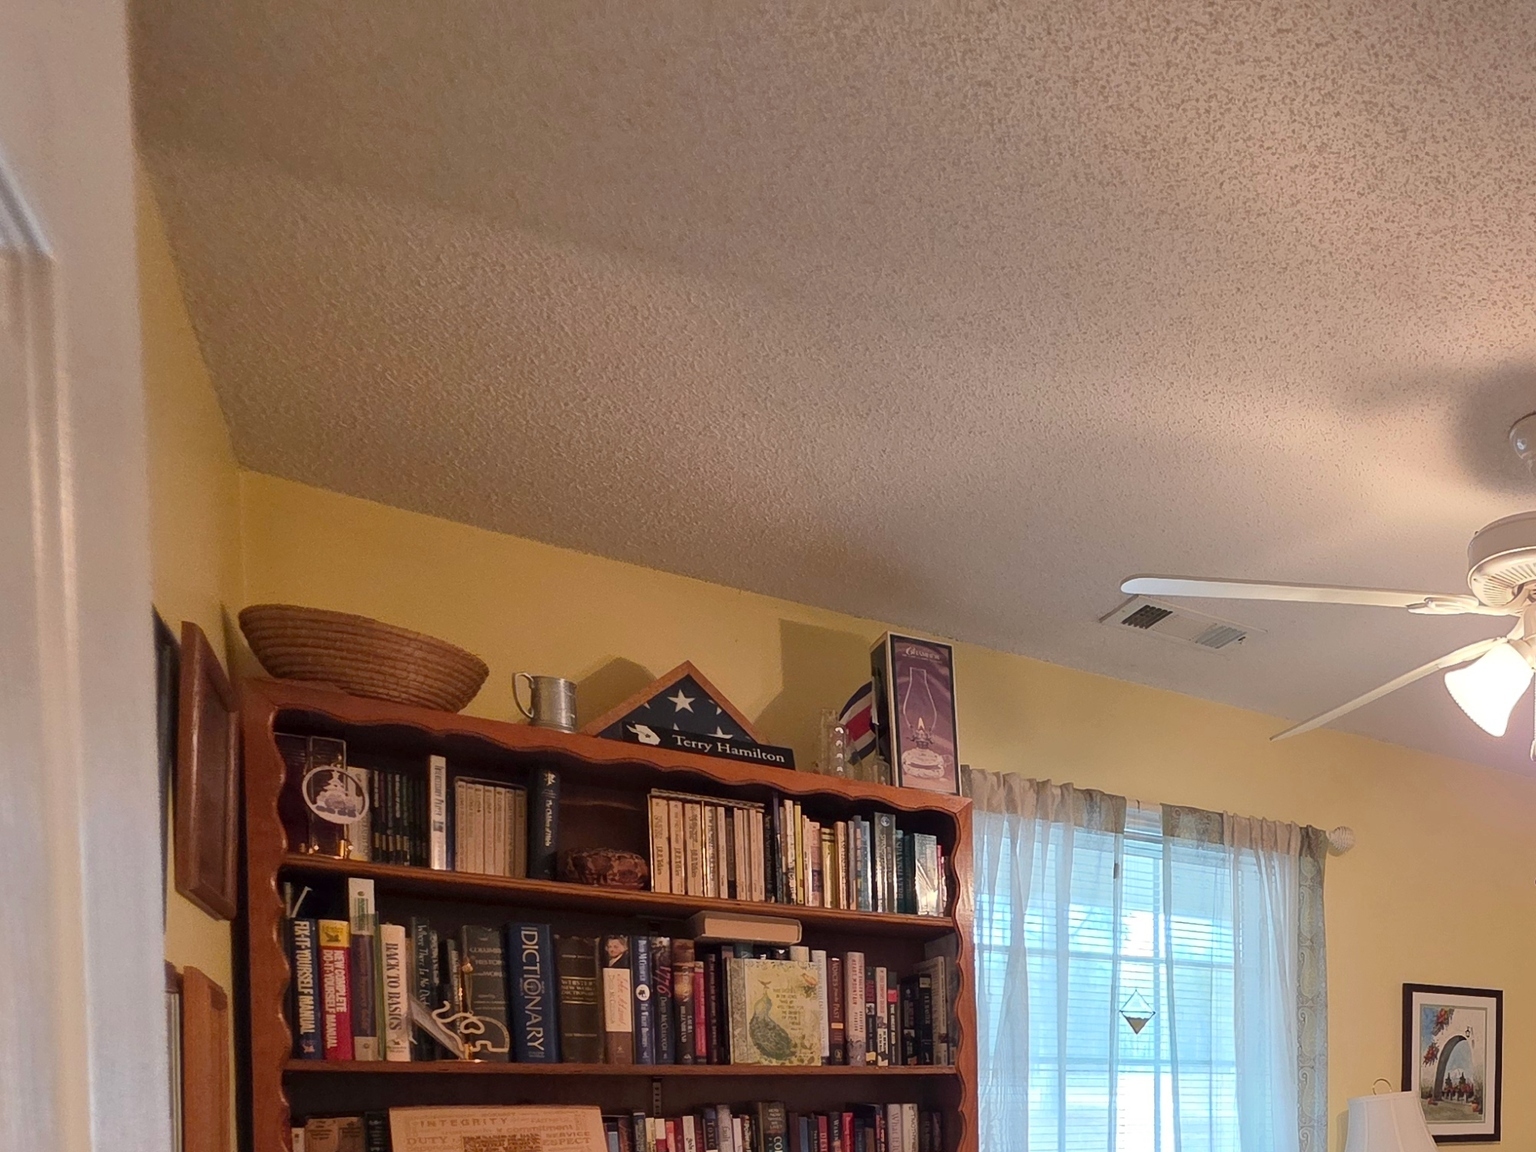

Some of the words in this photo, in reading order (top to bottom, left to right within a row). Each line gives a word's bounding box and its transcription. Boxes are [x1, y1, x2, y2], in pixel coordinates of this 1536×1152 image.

[672, 734, 712, 753] Terry
[717, 742, 785, 763] Hamilton
[294, 921, 313, 994] FIX-IT-YOURSELF
[334, 949, 344, 969] NEW
[385, 942, 402, 974] BACK
[334, 970, 347, 1012] COMPLETE
[386, 975, 401, 991] TO
[520, 930, 546, 1051] DICTIONARY
[653, 965, 672, 998] 1776
[298, 995, 315, 1034] MANUAL
[387, 991, 402, 1031] BASICS
[833, 1003, 841, 1019] PAST
[325, 1014, 338, 1048] MANUAL
[420, 1117, 507, 1129] INTEGRITY
[707, 1120, 716, 1148] TOXIC
[406, 1136, 447, 1146] DUTY
